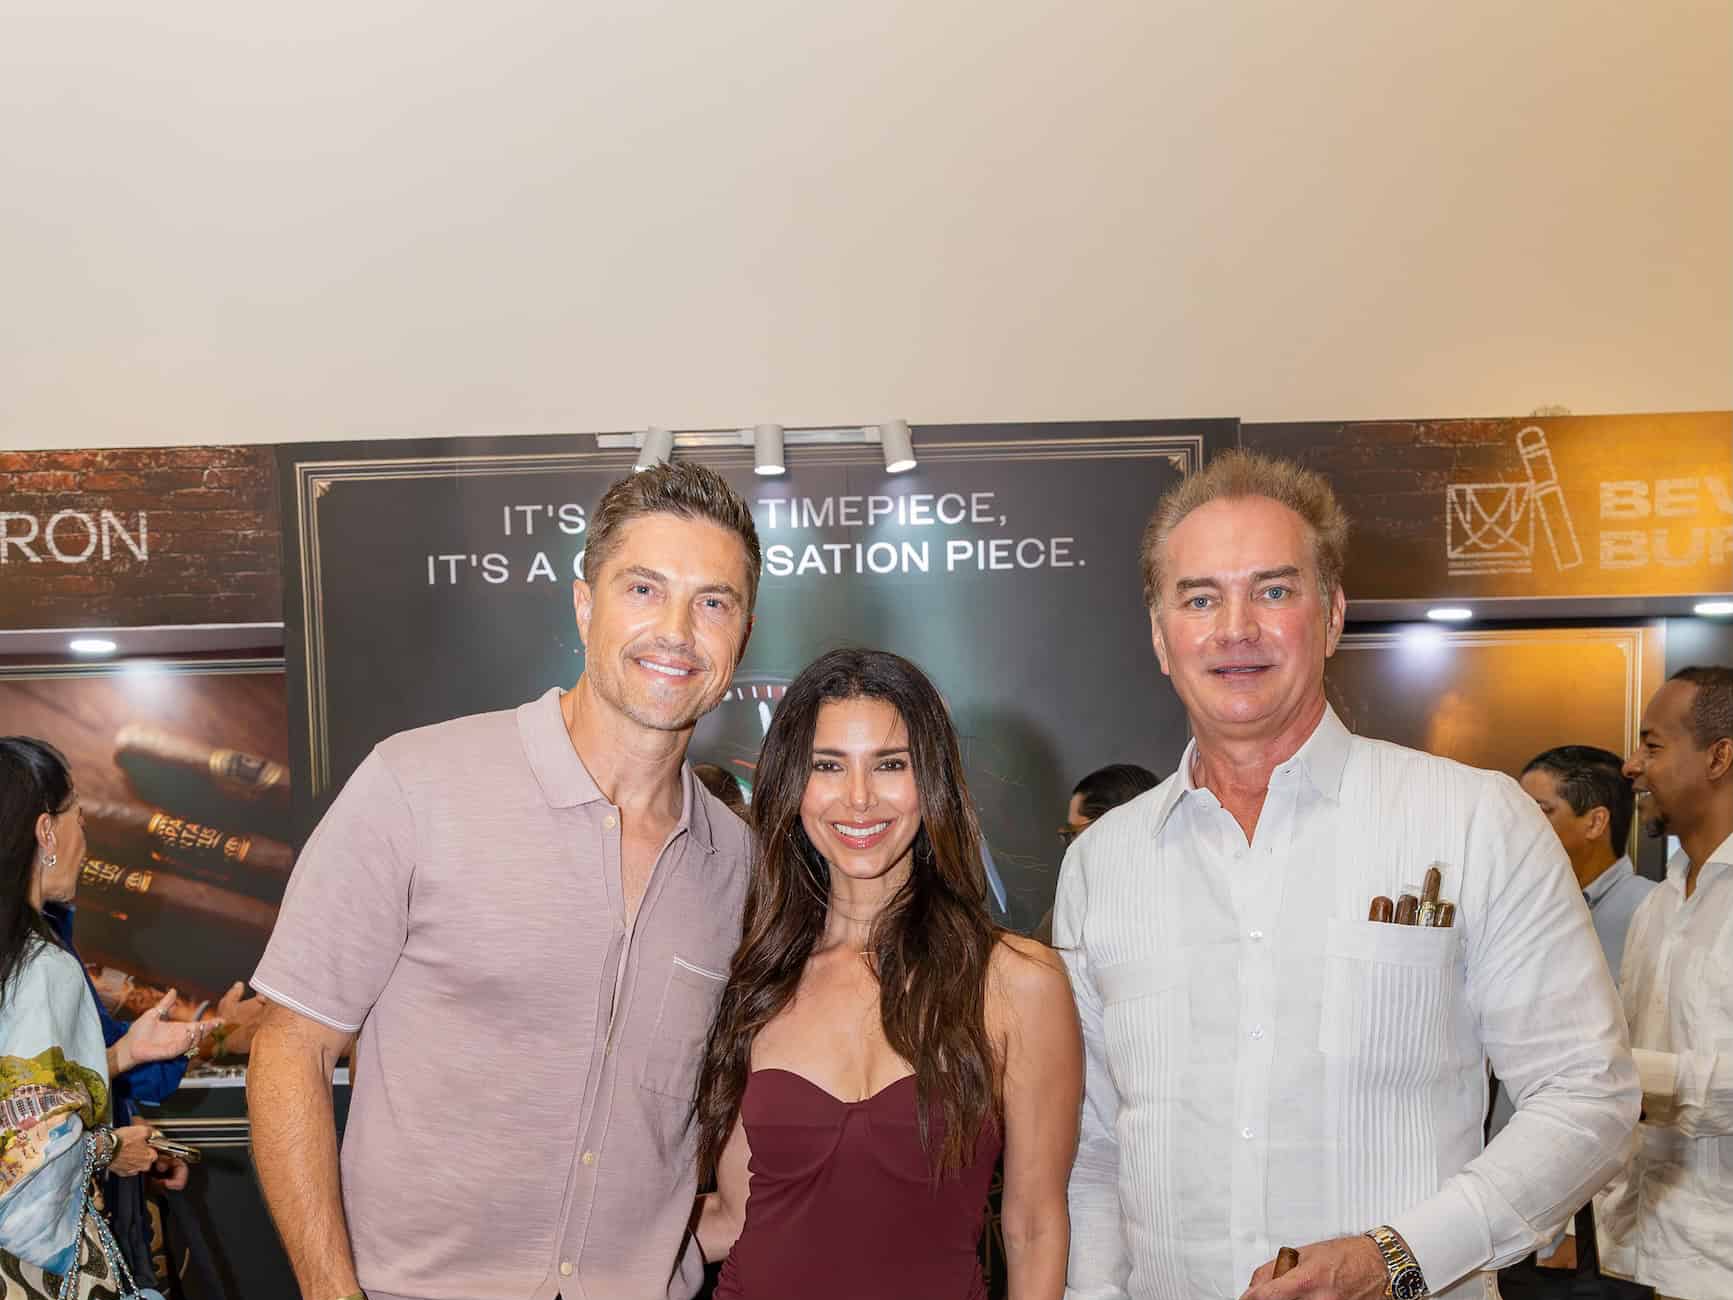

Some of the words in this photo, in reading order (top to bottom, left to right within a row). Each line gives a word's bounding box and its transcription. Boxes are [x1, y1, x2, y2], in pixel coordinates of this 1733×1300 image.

[0, 508, 149, 564] RON
[503, 503, 586, 536] IT'S
[758, 492, 1007, 529] TIMEPIECE,
[428, 553, 510, 585] IT'S
[526, 551, 557, 583] A
[947, 537, 1085, 573] PIECE.
